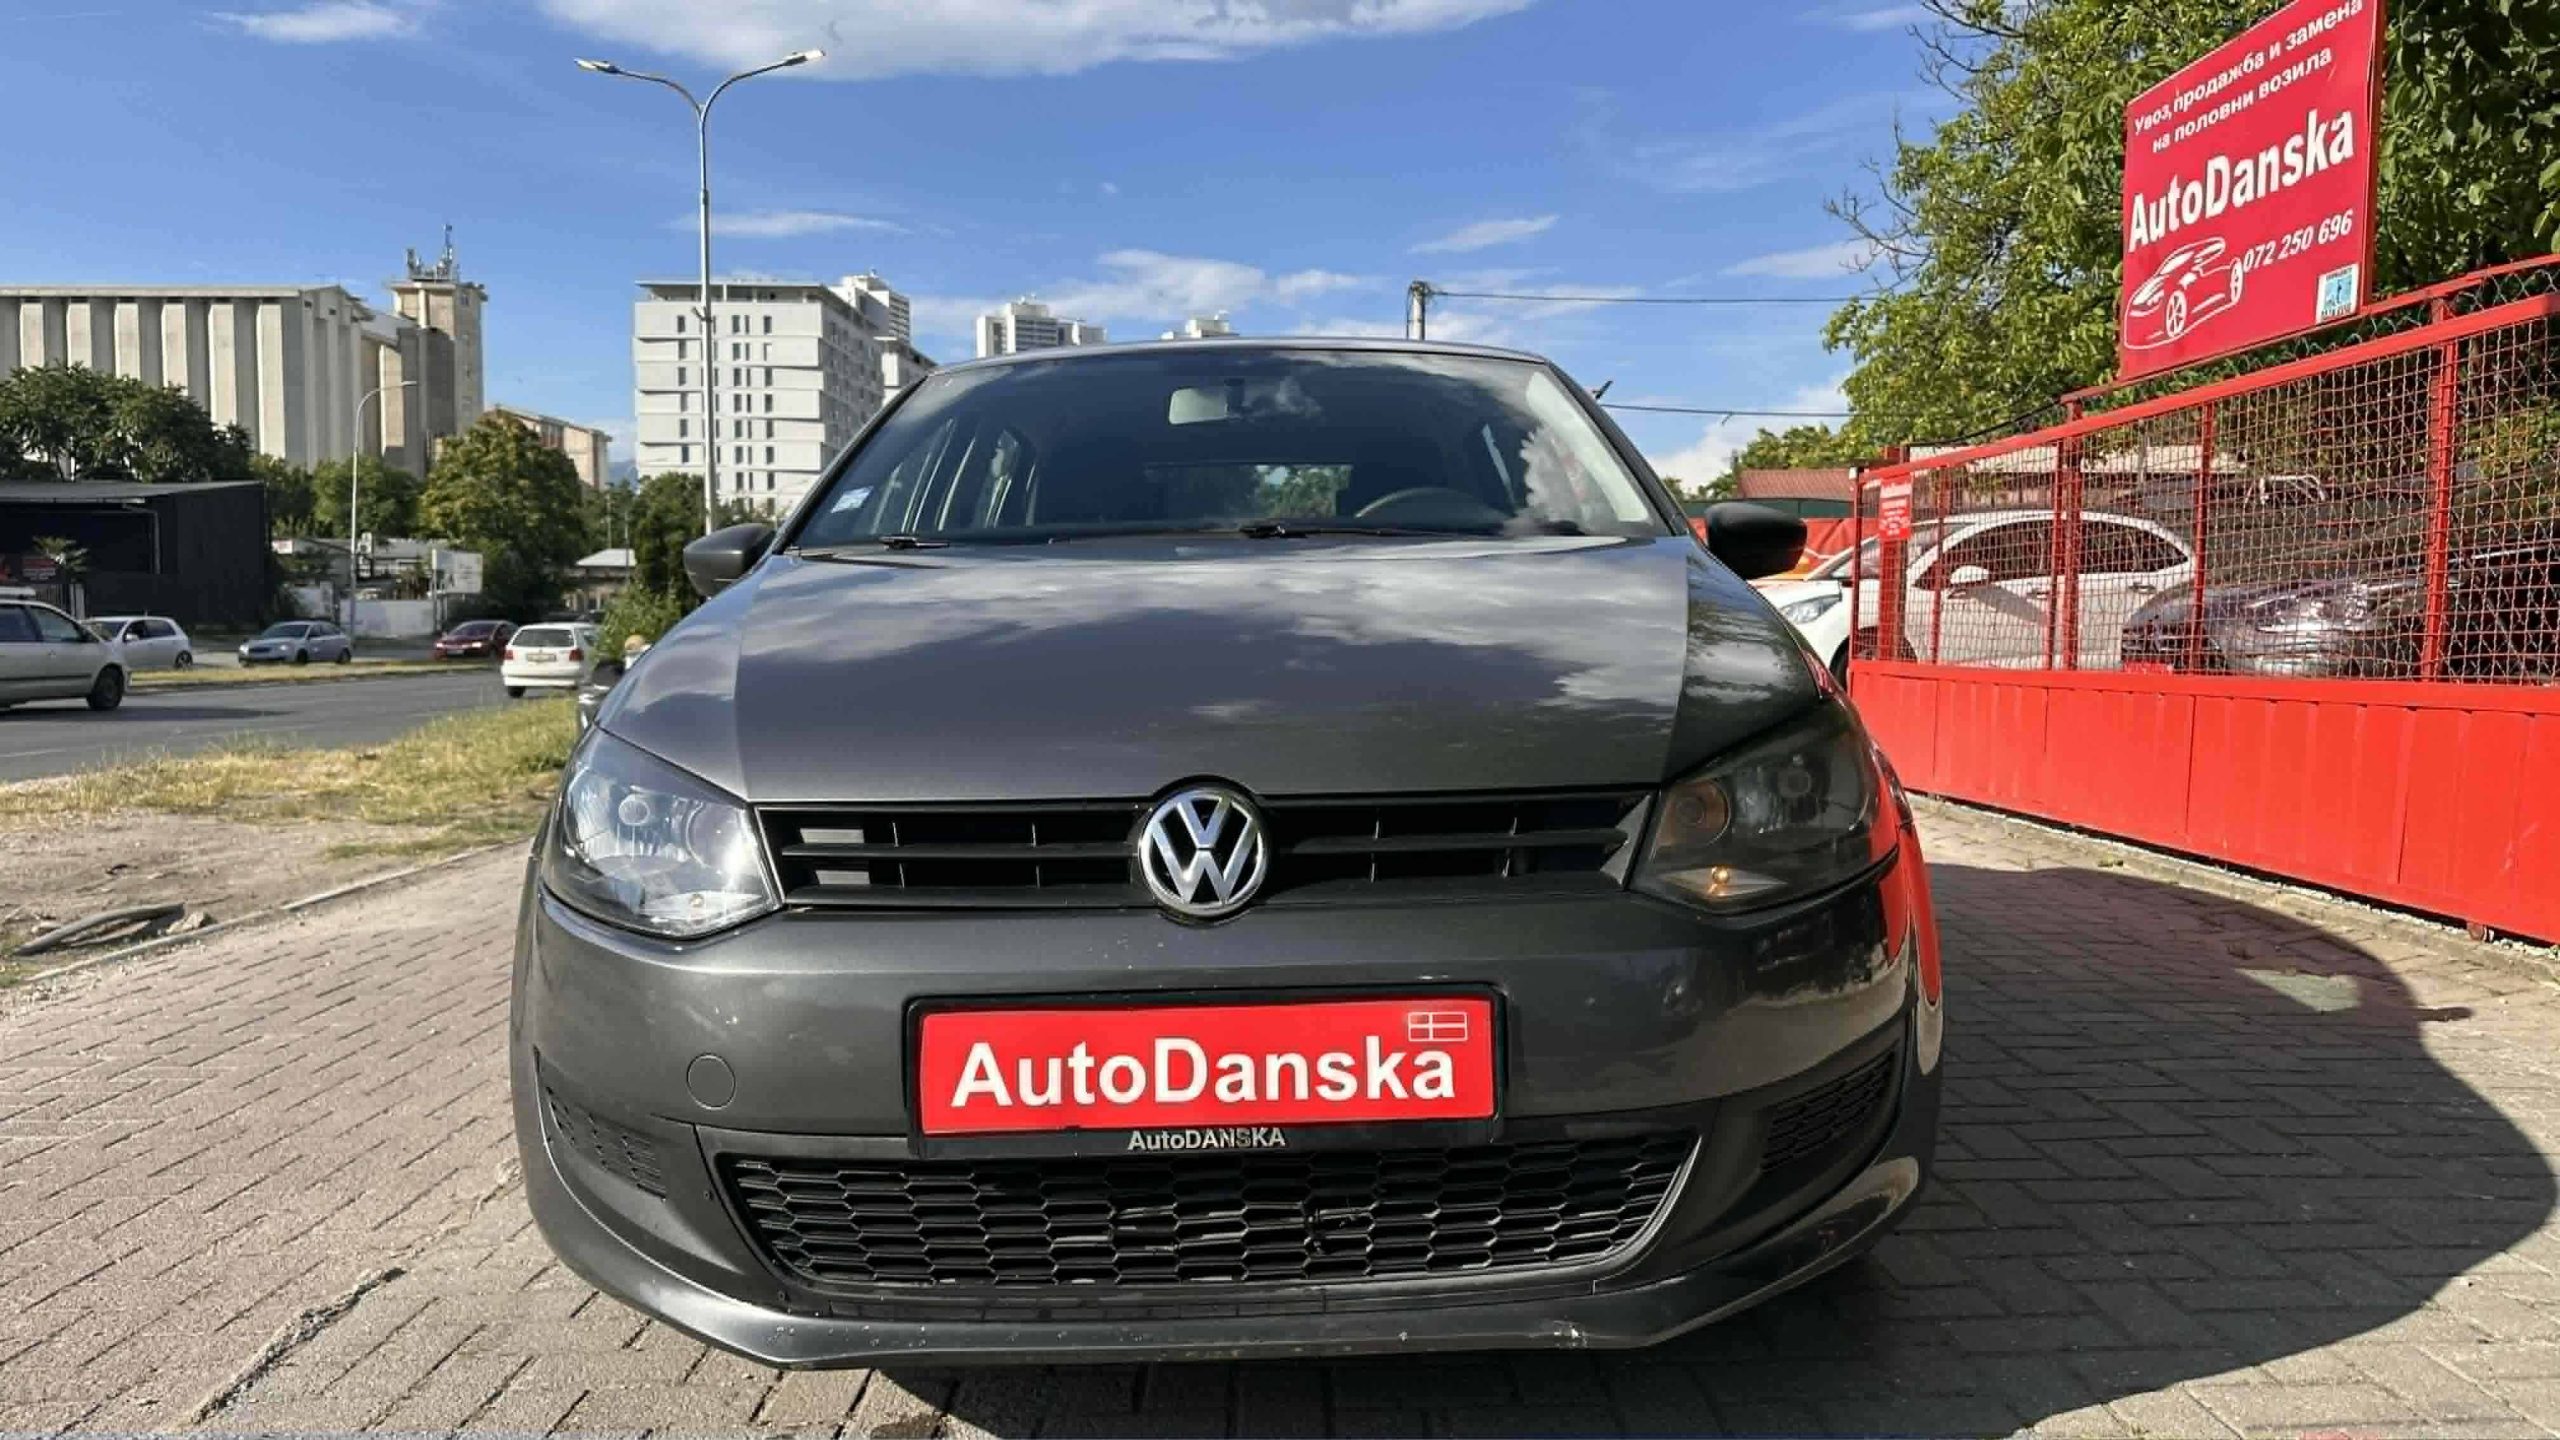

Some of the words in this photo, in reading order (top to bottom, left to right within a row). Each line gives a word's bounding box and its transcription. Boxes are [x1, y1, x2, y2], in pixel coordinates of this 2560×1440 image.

[2153, 132, 2170, 153] на
[2174, 89, 2254, 142] половни
[2258, 47, 2332, 100] возила
[2174, 52, 2264, 113] продажба
[2269, 41, 2281, 61] и
[2286, 0, 2363, 51] замена
[2128, 109, 2354, 252] AutoDanska
[2243, 240, 2276, 273] 072
[2278, 225, 2314, 260] 250
[2318, 209, 2353, 244] 696
[1145, 793, 1260, 908] VW
[951, 1035, 1455, 1108] AutoDanska
[1127, 1127, 1286, 1150] AutoDANSKA
